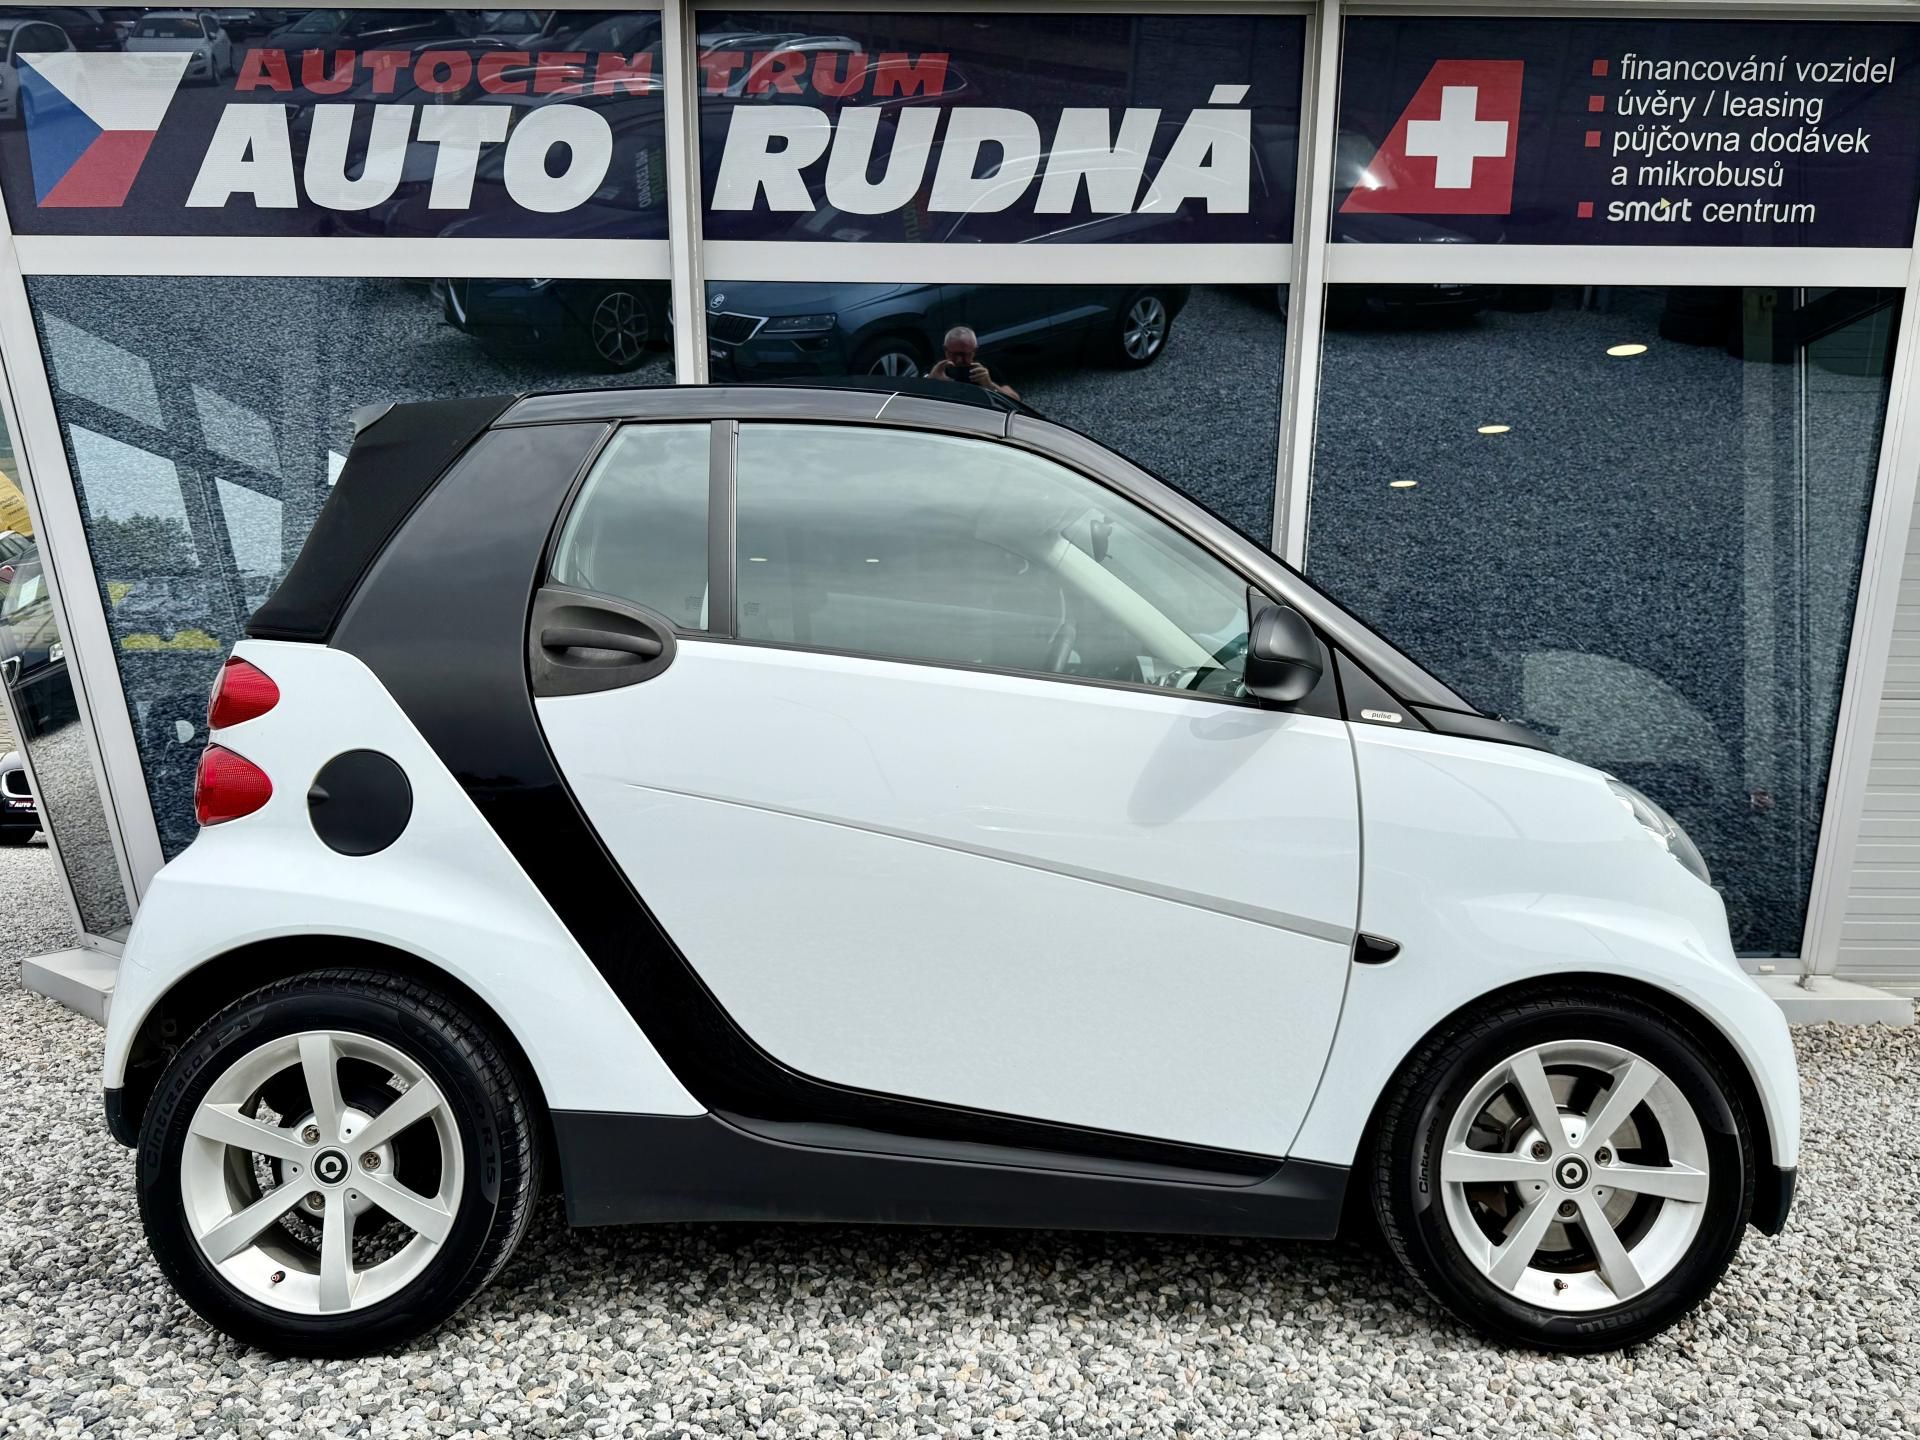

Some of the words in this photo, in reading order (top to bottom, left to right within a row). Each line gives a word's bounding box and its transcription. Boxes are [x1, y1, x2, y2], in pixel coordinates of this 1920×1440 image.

[1621, 54, 1787, 81] financování
[1796, 57, 1895, 83] vozidel
[1618, 89, 1696, 123] úvěry
[1703, 90, 1715, 116] /
[1723, 91, 1823, 124] leasing
[185, 103, 613, 213] AUTO
[710, 84, 1251, 214] RUDNÁ
[1613, 124, 1739, 157] půjčovna
[1751, 127, 1870, 153] dodávek
[1611, 166, 1627, 186] a
[1638, 161, 1783, 186] mikrobusů
[1607, 198, 1692, 222] smart
[1702, 199, 1816, 223] centrum
[1371, 712, 1392, 720] pulse
